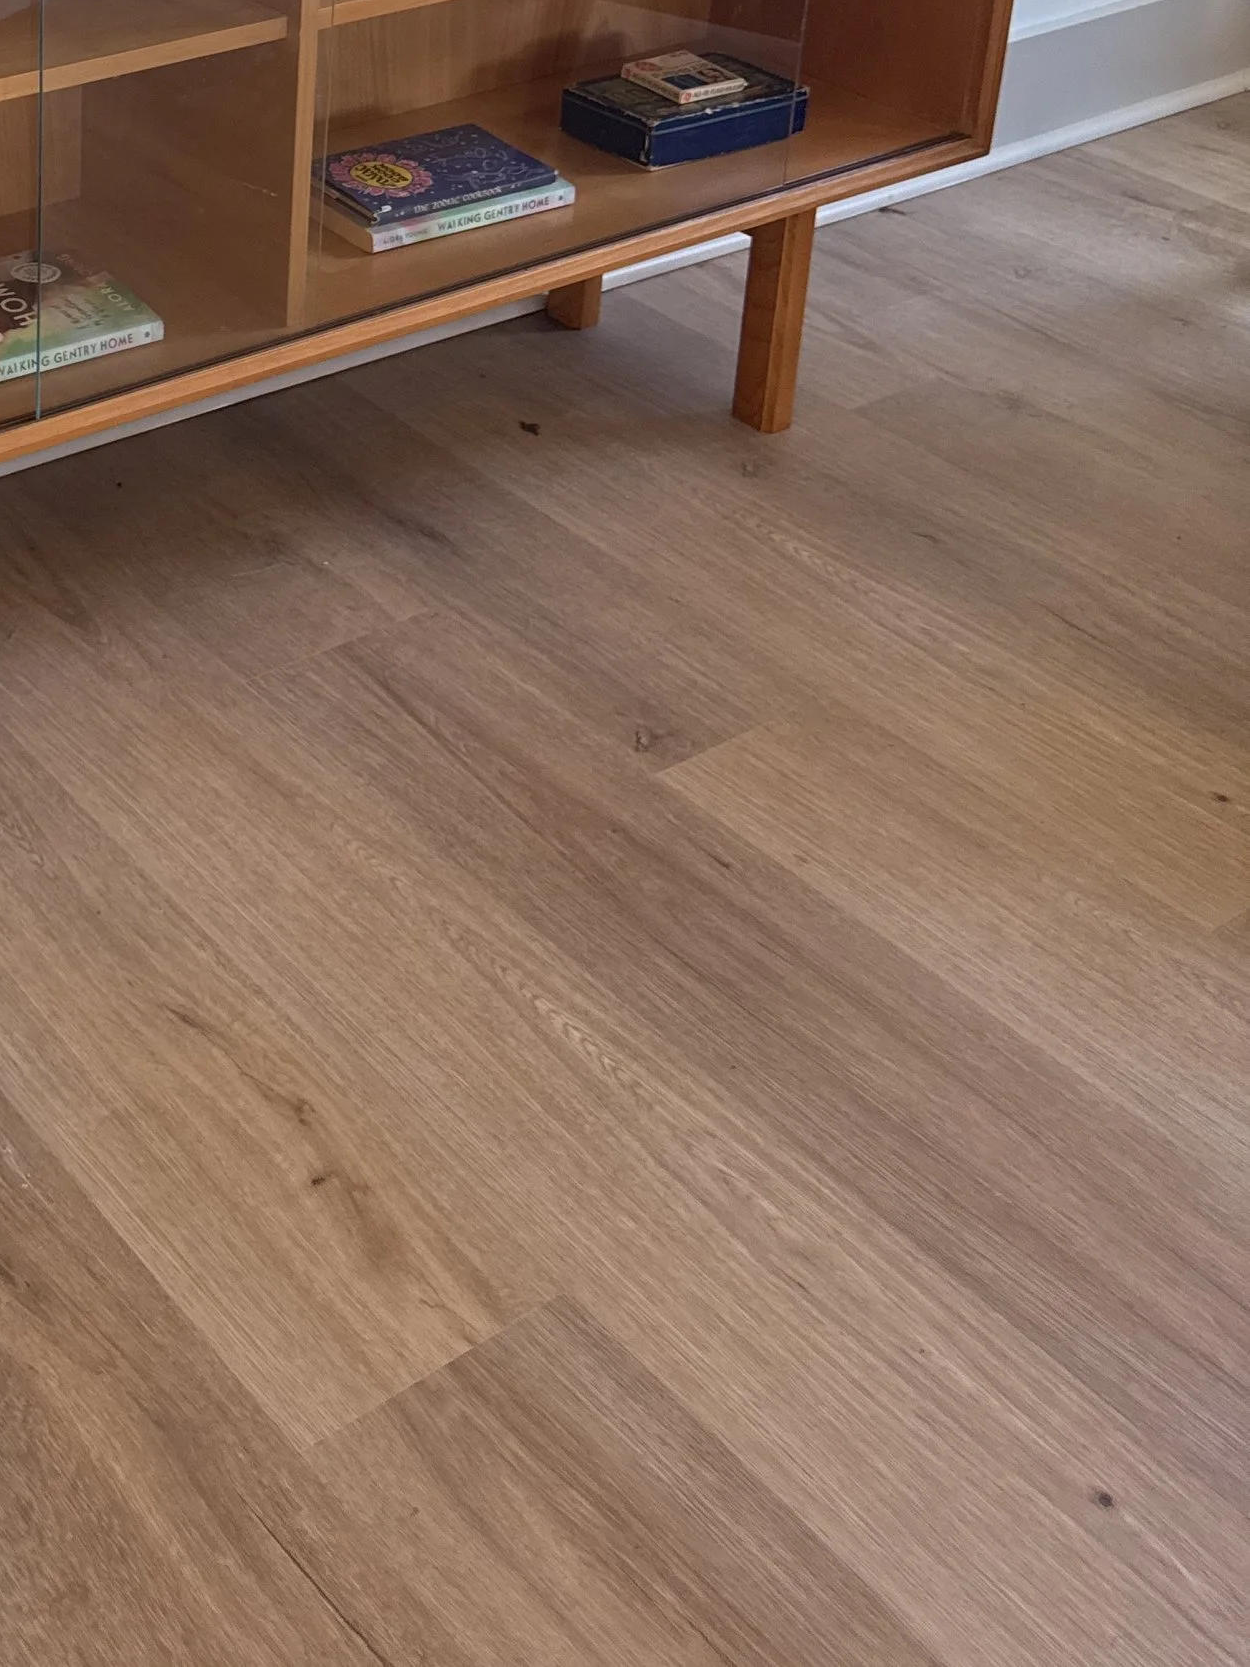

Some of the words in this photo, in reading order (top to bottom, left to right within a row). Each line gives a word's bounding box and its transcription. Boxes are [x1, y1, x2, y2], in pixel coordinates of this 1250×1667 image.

[437, 213, 482, 232] WALKING
[483, 202, 522, 222] GENTRY
[521, 196, 551, 212] HOME
[53, 343, 98, 364] GENTRY
[100, 333, 134, 351] HOME
